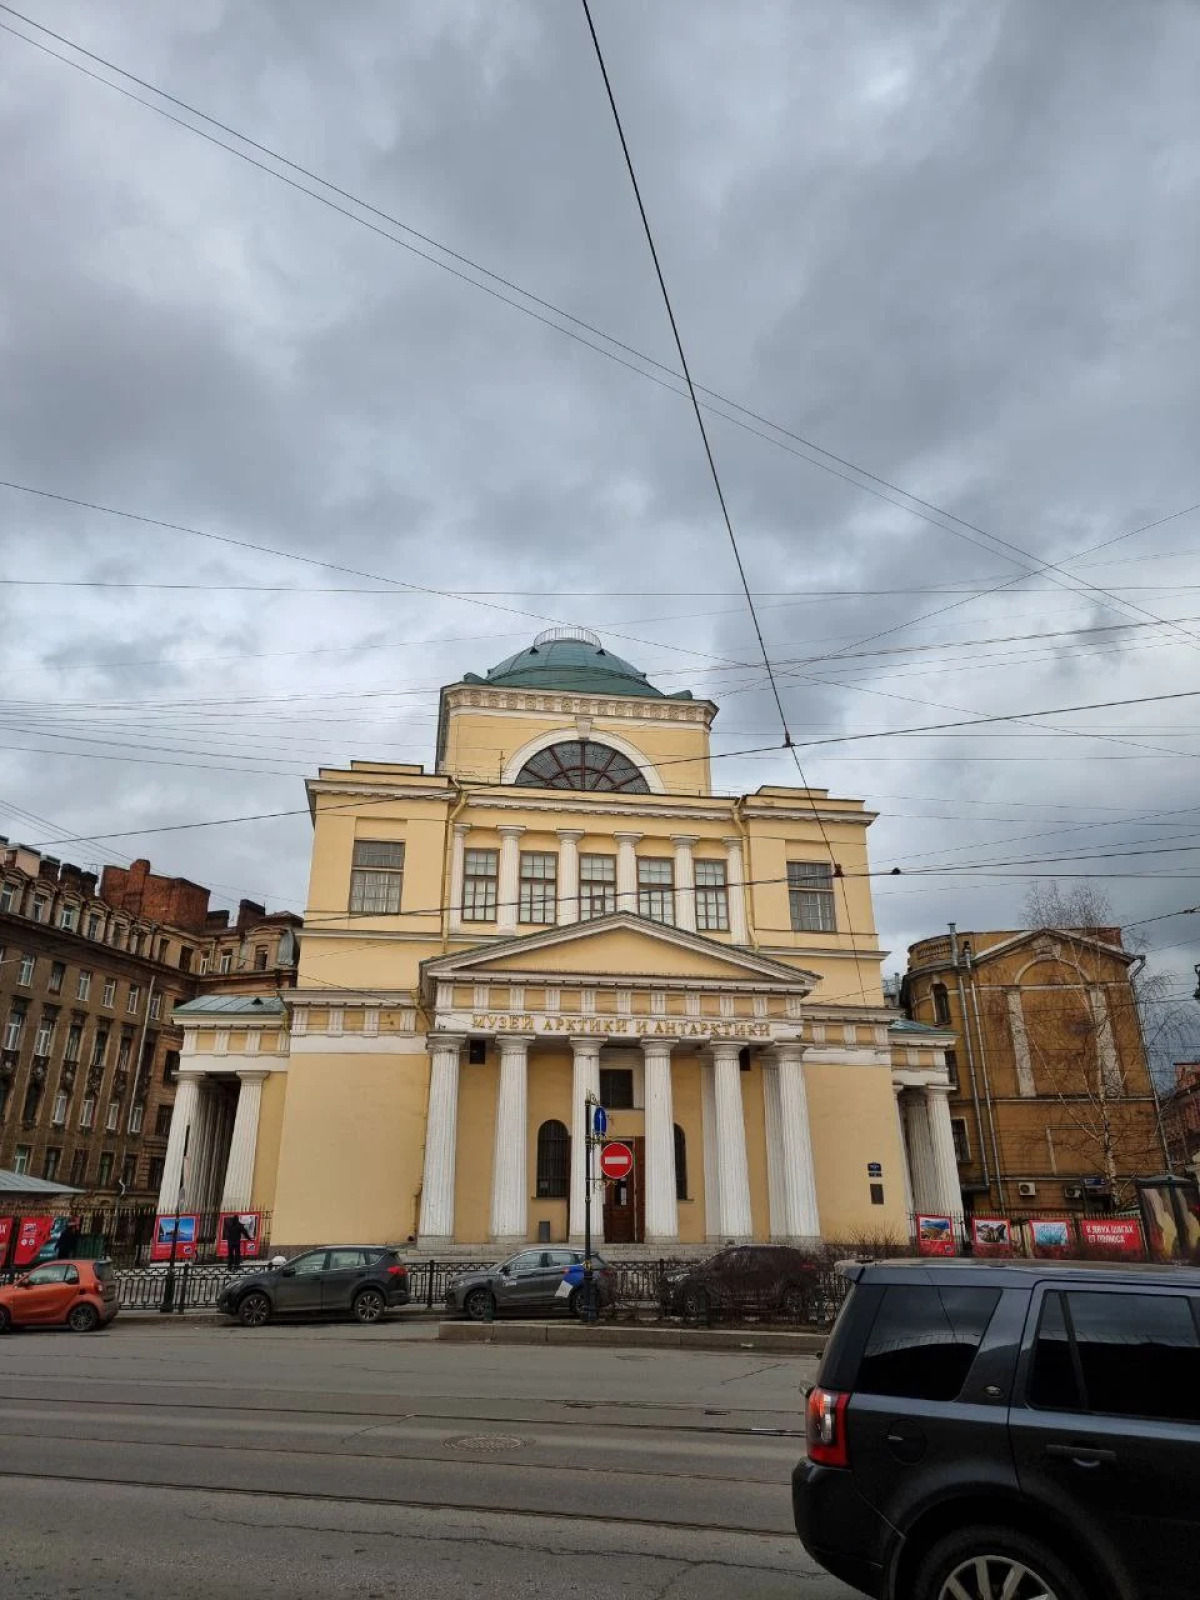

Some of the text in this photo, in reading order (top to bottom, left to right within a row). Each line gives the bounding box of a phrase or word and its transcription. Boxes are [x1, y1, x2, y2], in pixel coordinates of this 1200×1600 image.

[471, 1014, 771, 1036] МУЗЕЙ АРКТИКИ И АНТАРКТИКИ
